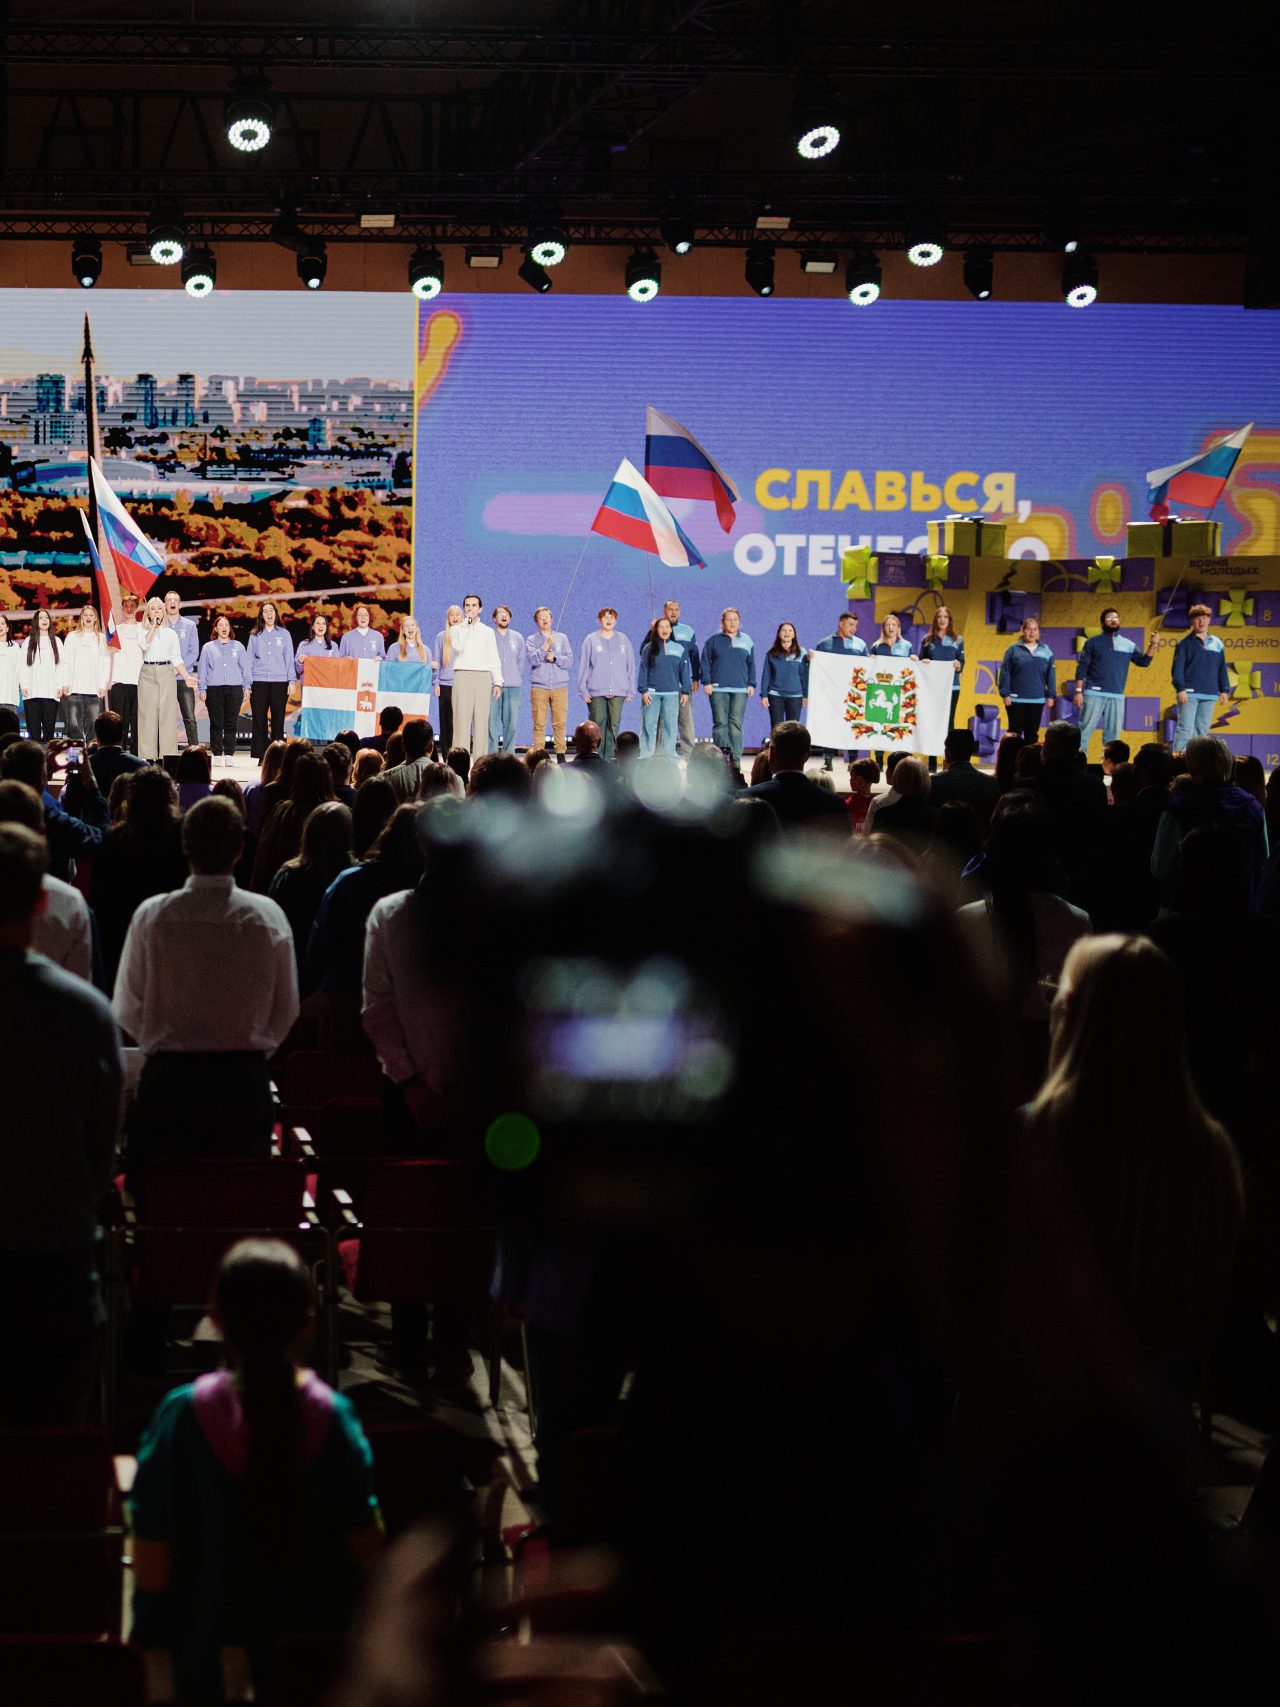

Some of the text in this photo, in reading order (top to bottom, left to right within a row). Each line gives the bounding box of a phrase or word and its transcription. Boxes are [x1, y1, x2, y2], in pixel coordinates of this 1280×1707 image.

[754, 467, 1032, 522] СЛАВЬСЯ,
[1200, 566, 1259, 576] молодых
[1263, 609, 1272, 622] 8
[1156, 634, 1280, 652] роодёжь
[1144, 715, 1153, 727] 11
[1266, 753, 1279, 765] 12
